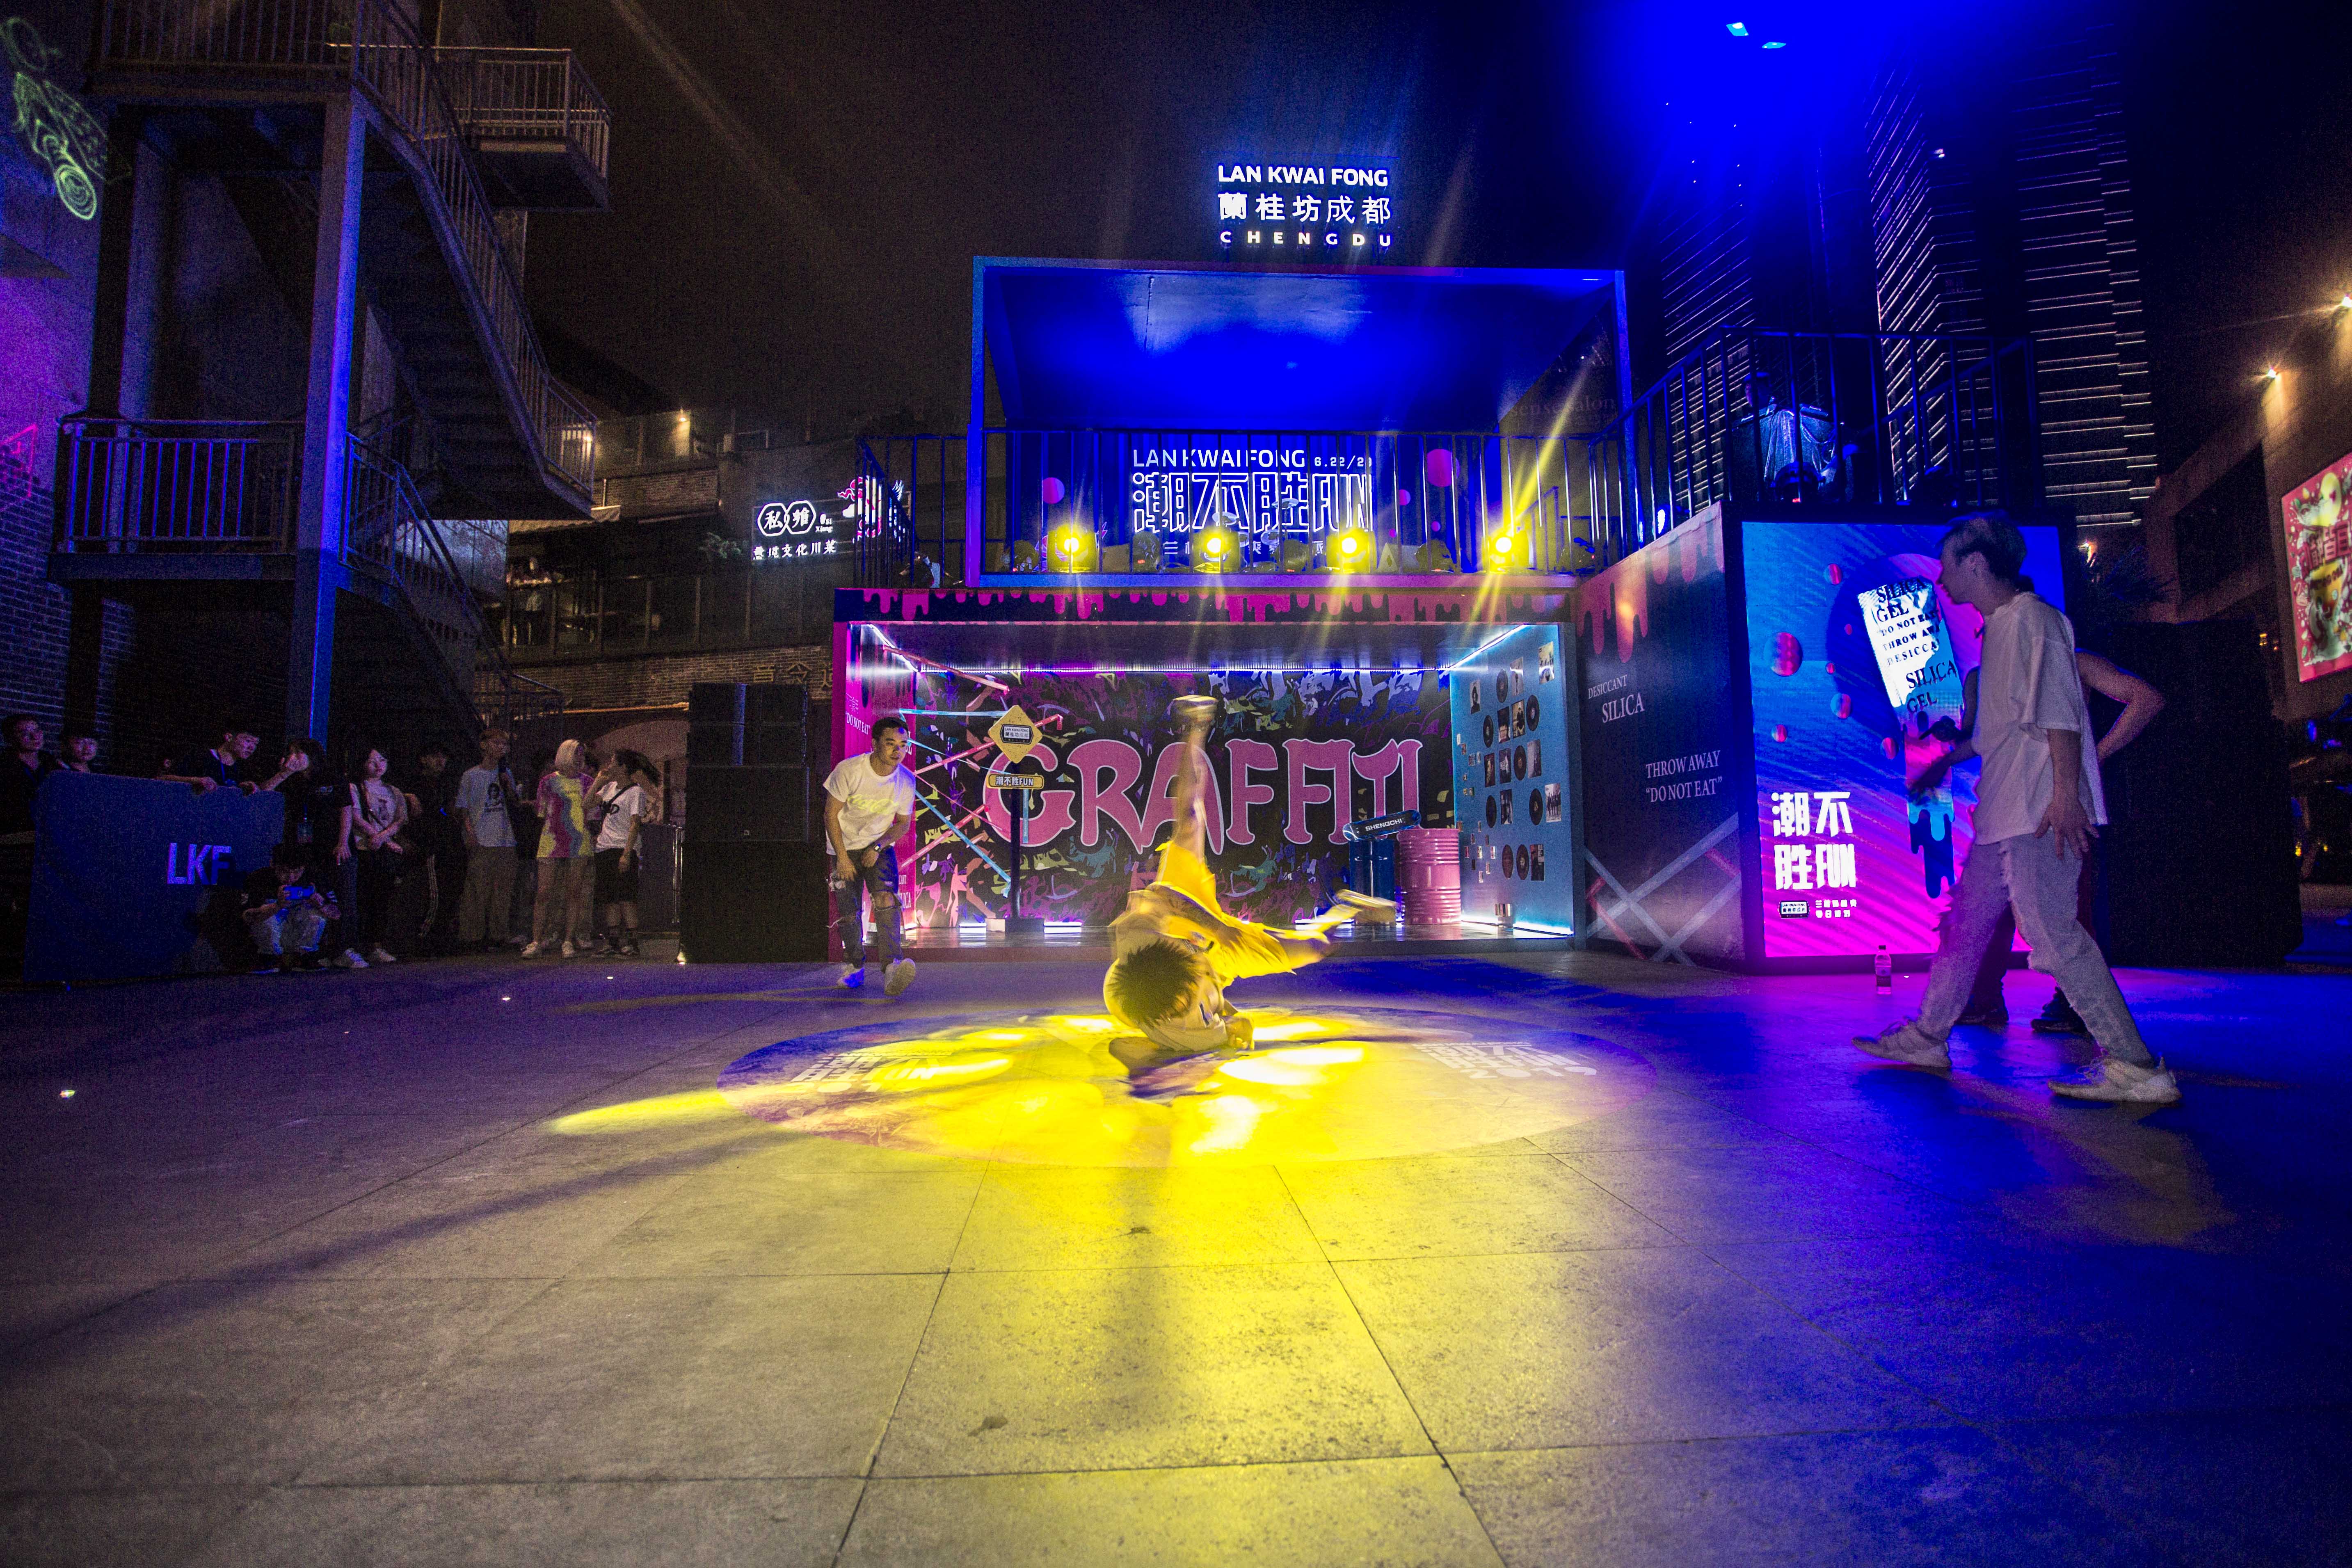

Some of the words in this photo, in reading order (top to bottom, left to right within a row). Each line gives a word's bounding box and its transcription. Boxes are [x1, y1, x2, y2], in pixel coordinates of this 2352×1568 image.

[1218, 165, 1261, 182] LAN
[1268, 165, 1324, 184] KWAI
[1331, 168, 1388, 186] FONG
[1218, 192, 1391, 224] 蘭桂坊成都
[1220, 230, 1391, 247] CHENGDU
[1134, 449, 1176, 467] LAN
[1182, 449, 1241, 467] KWAI
[1246, 449, 1305, 468] FONG
[1876, 577, 1927, 603] SILICA
[1877, 602, 1909, 622] GEL
[1881, 626, 1894, 636] DO
[1897, 617, 1915, 630] NOT
[1883, 632, 1917, 651] THROW
[1906, 660, 1957, 689] SILICA
[1588, 674, 1627, 699] DESICCANT
[1602, 692, 1645, 724] SILICA
[1906, 692, 1937, 714] GEL
[853, 717, 862, 731] NOT
[1646, 757, 1688, 778] THROW
[1688, 750, 1721, 772] AWAY
[996, 776, 1033, 786] 潮不胜FUN
[1668, 782, 1693, 800] NOT
[1771, 792, 1853, 837] 潮不
[1365, 818, 1403, 832] SHENGCHI
[167, 842, 231, 885] LKF
[1460, 1066, 1597, 1079] 2019
